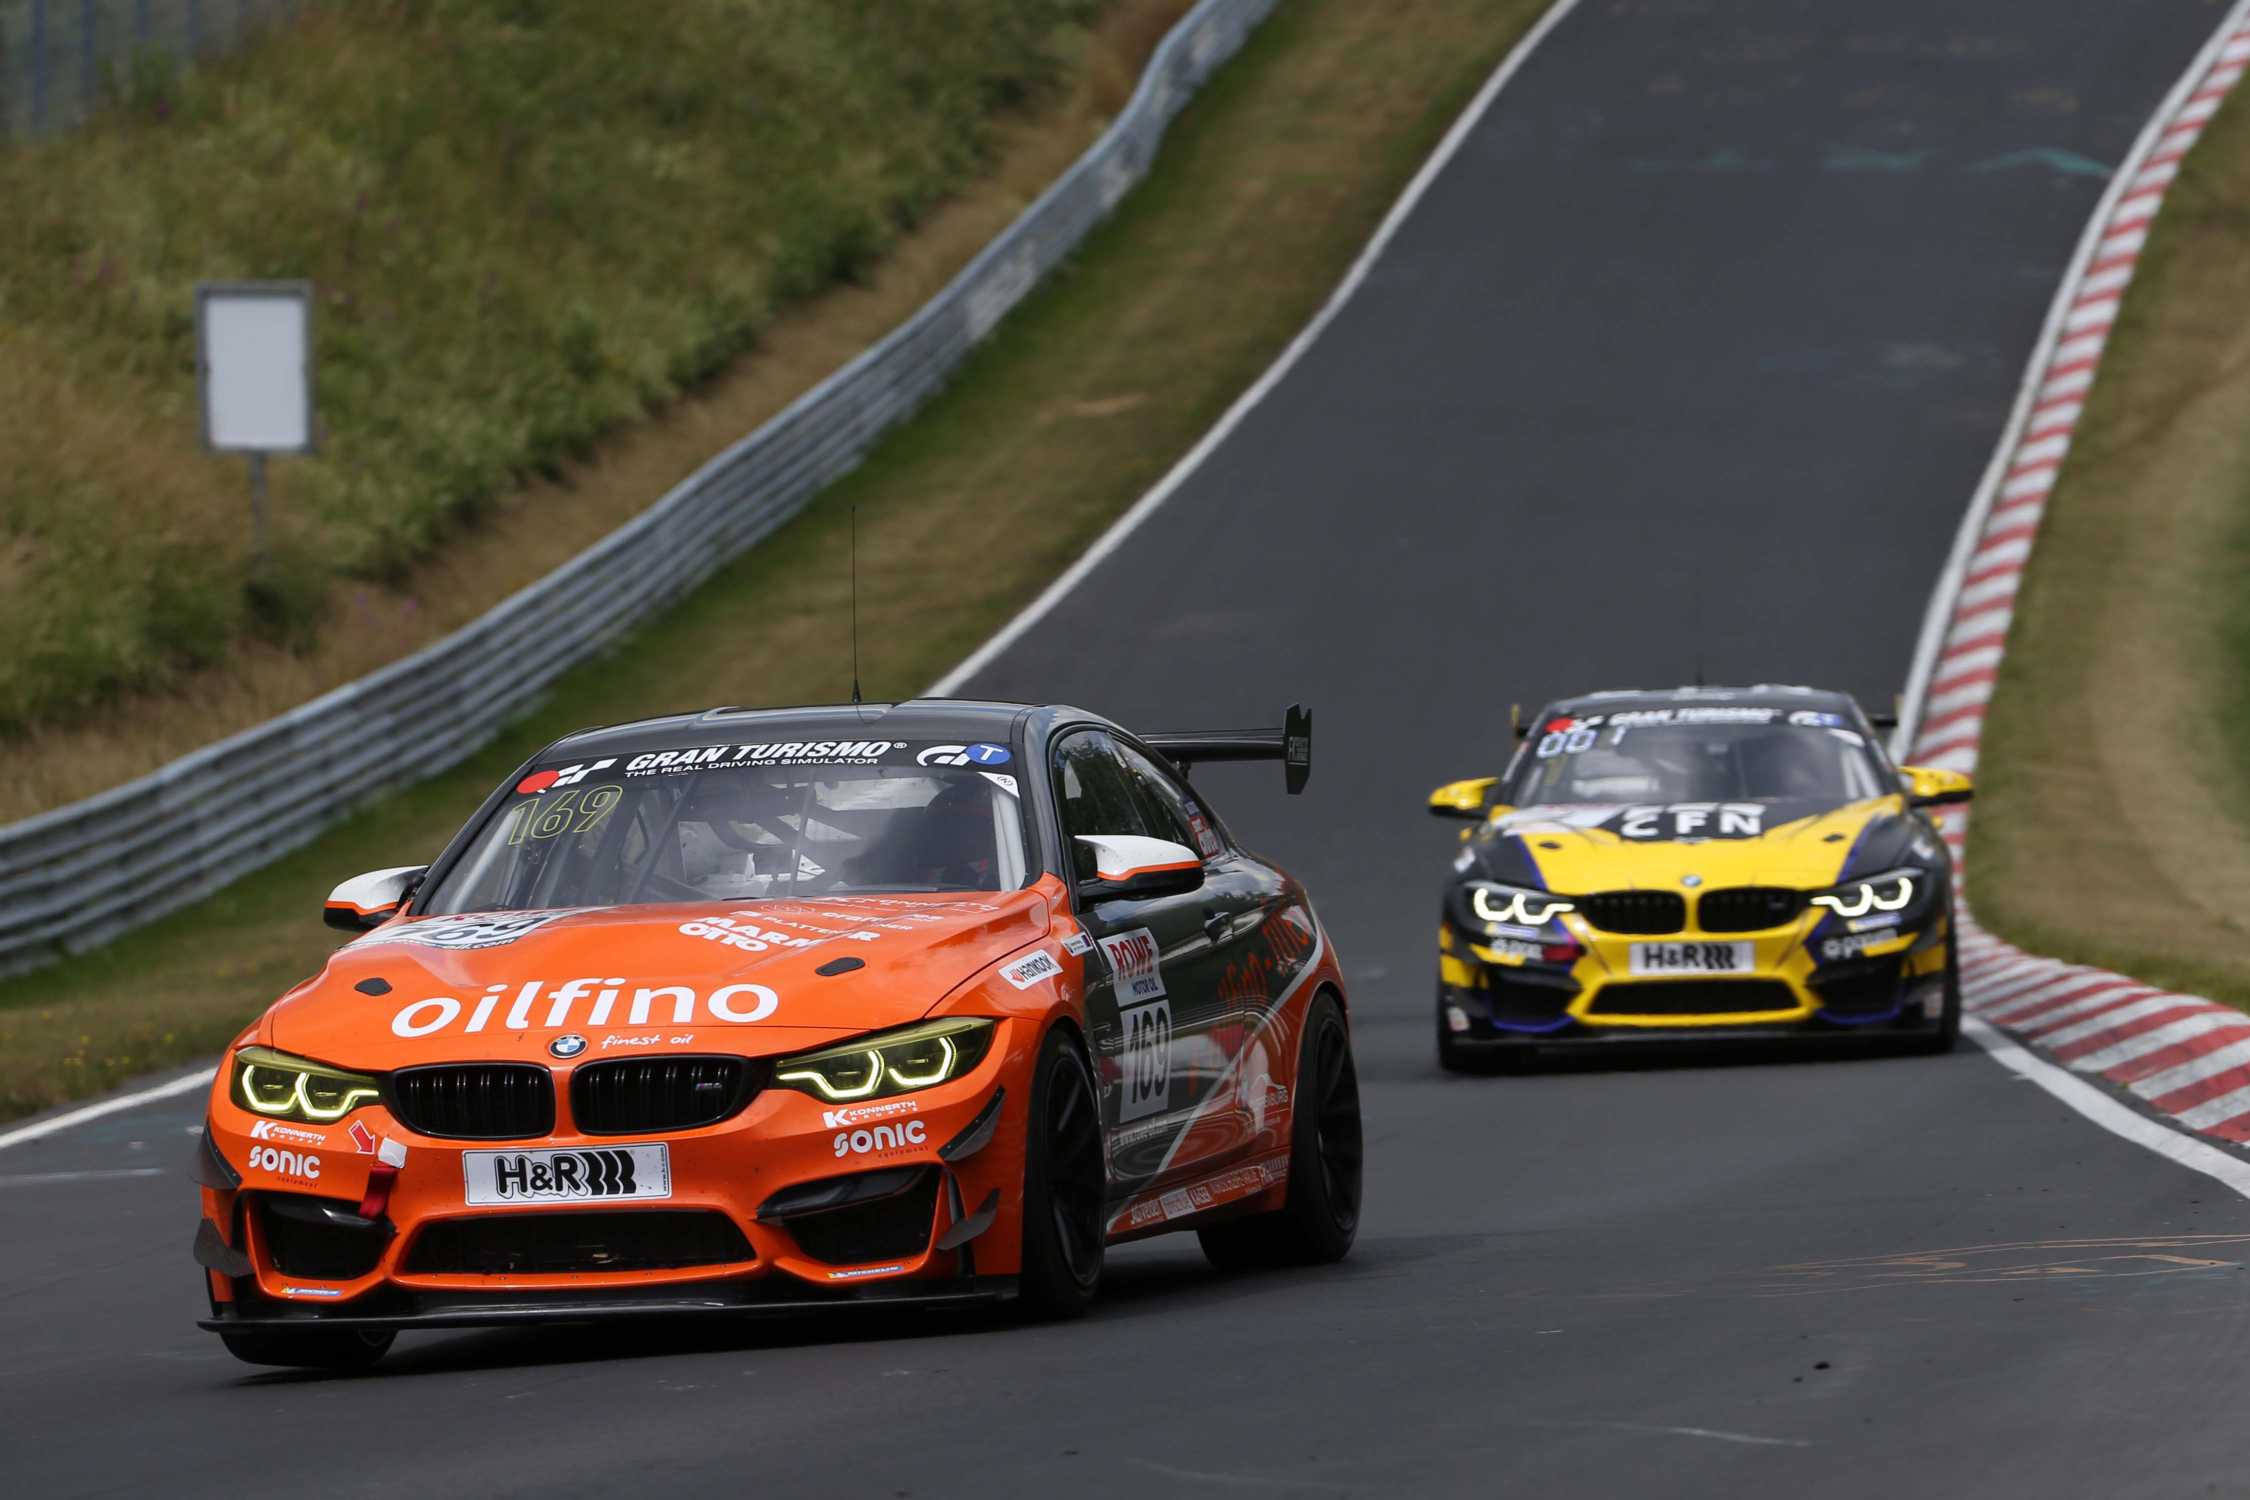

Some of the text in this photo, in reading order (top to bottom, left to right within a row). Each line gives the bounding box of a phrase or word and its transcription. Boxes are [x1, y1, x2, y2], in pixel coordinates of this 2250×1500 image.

[625, 757, 879, 778] THE REAL DRIVING SIMULATOR
[626, 747, 730, 770] GRAN
[508, 784, 623, 847] 169
[678, 922, 769, 951] OTTO
[1107, 935, 1153, 982] ROWE
[390, 977, 779, 1037] oilfino
[601, 1034, 695, 1049] finest oil
[1129, 1007, 1170, 1104] 169
[849, 1100, 917, 1117] KONNERTH
[494, 1155, 584, 1196] H&R
